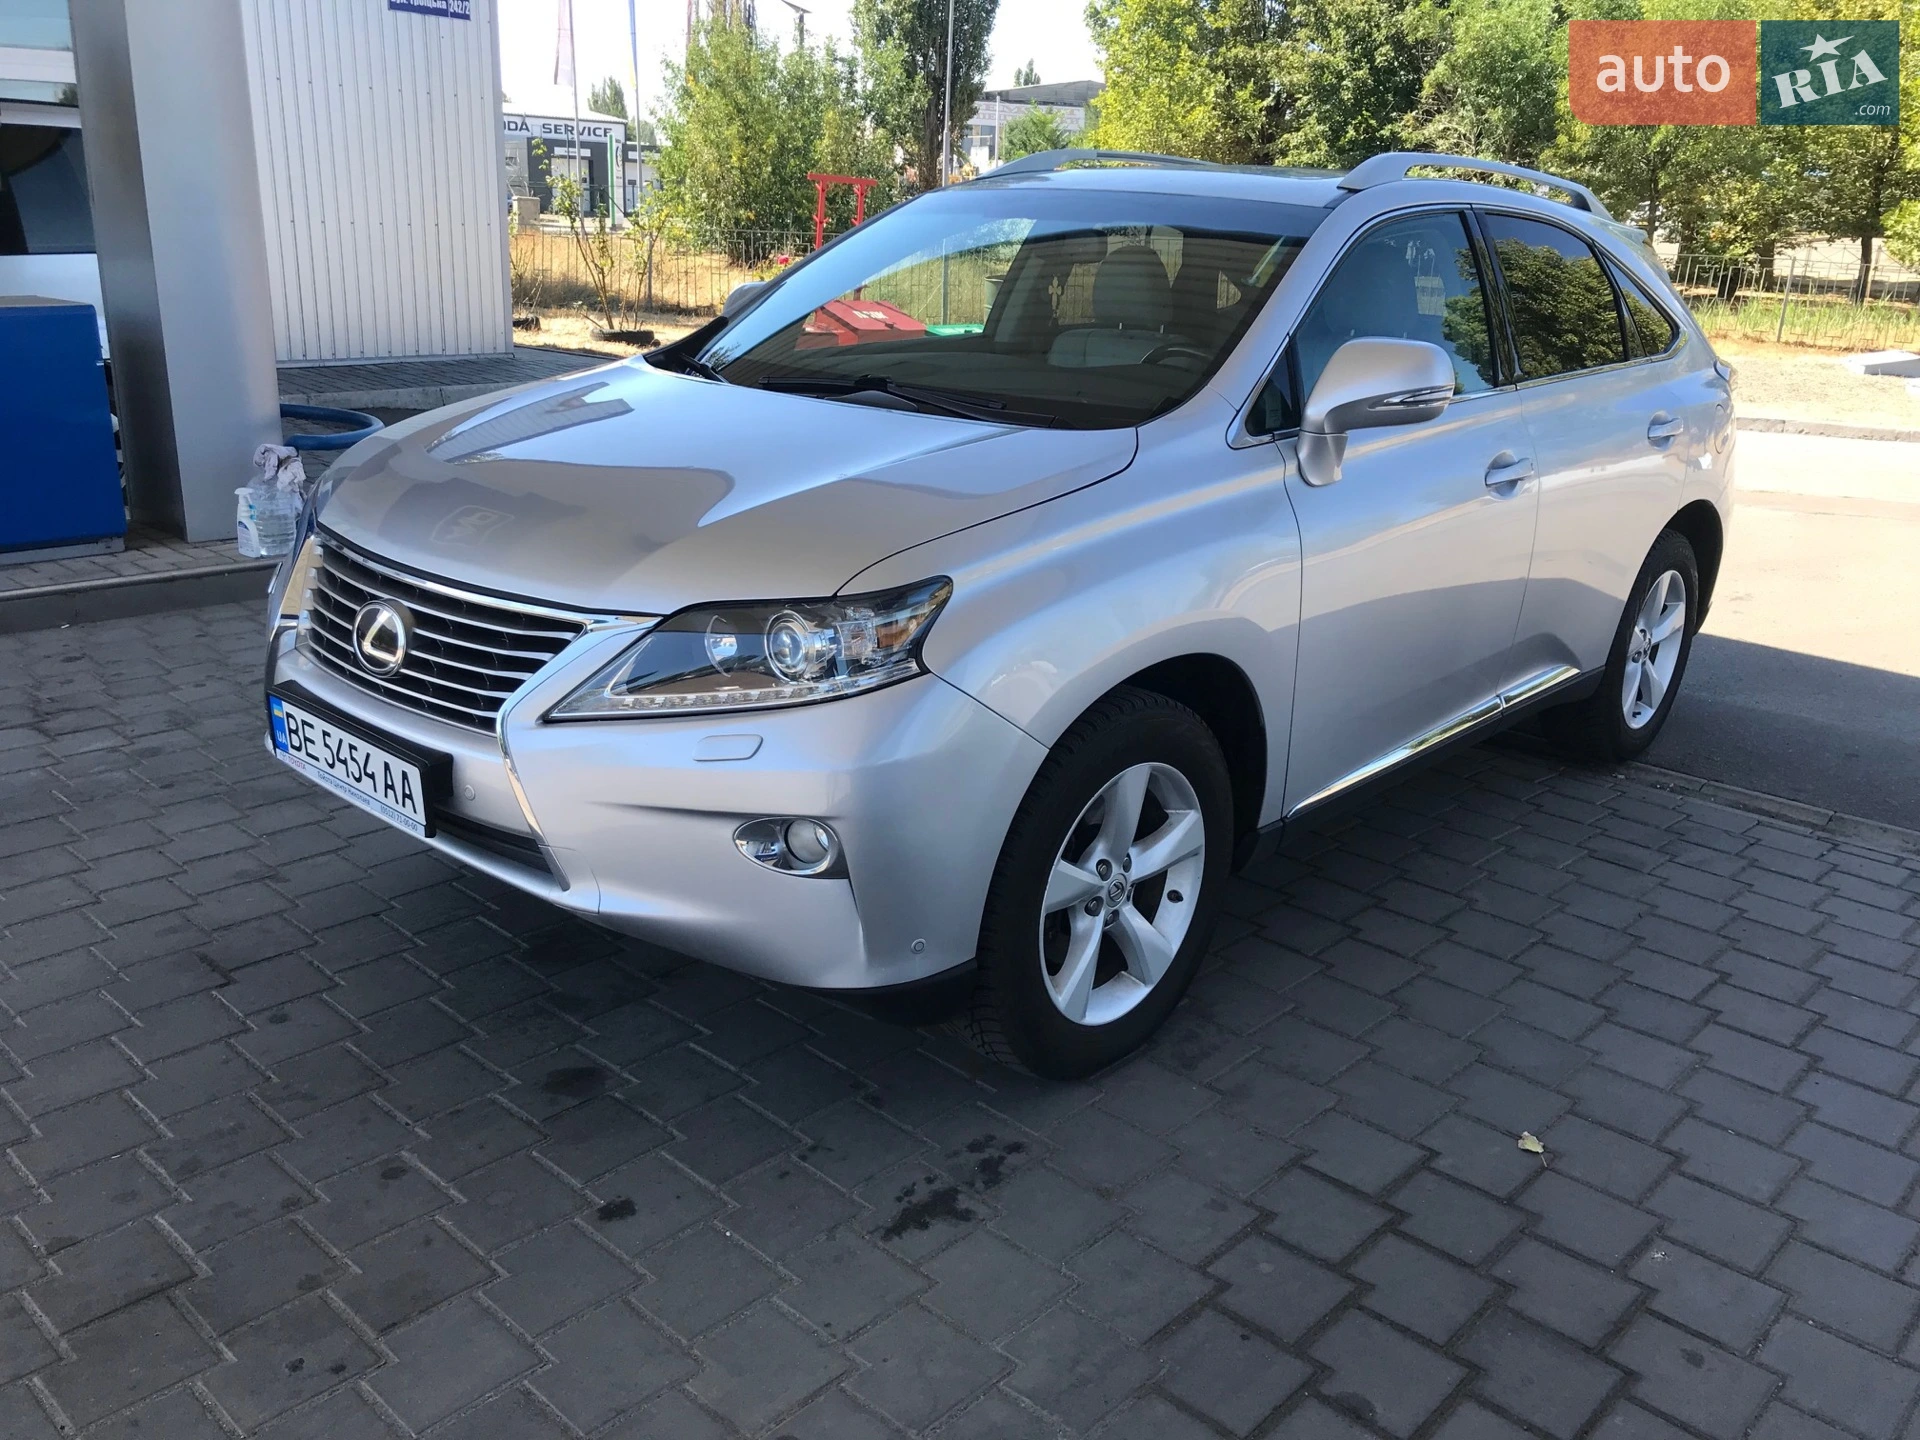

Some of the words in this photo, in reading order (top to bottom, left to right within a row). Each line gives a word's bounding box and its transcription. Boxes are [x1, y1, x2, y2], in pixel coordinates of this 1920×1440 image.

[449, 0, 470, 14] 242/2
[504, 120, 530, 132] DA
[542, 123, 613, 138] SERVICE
[276, 730, 288, 744] UA
[285, 710, 320, 763] BE
[322, 728, 378, 794] 5454
[383, 760, 418, 815] AA
[287, 755, 307, 771] TOYOTA
[380, 804, 396, 821] (0512)
